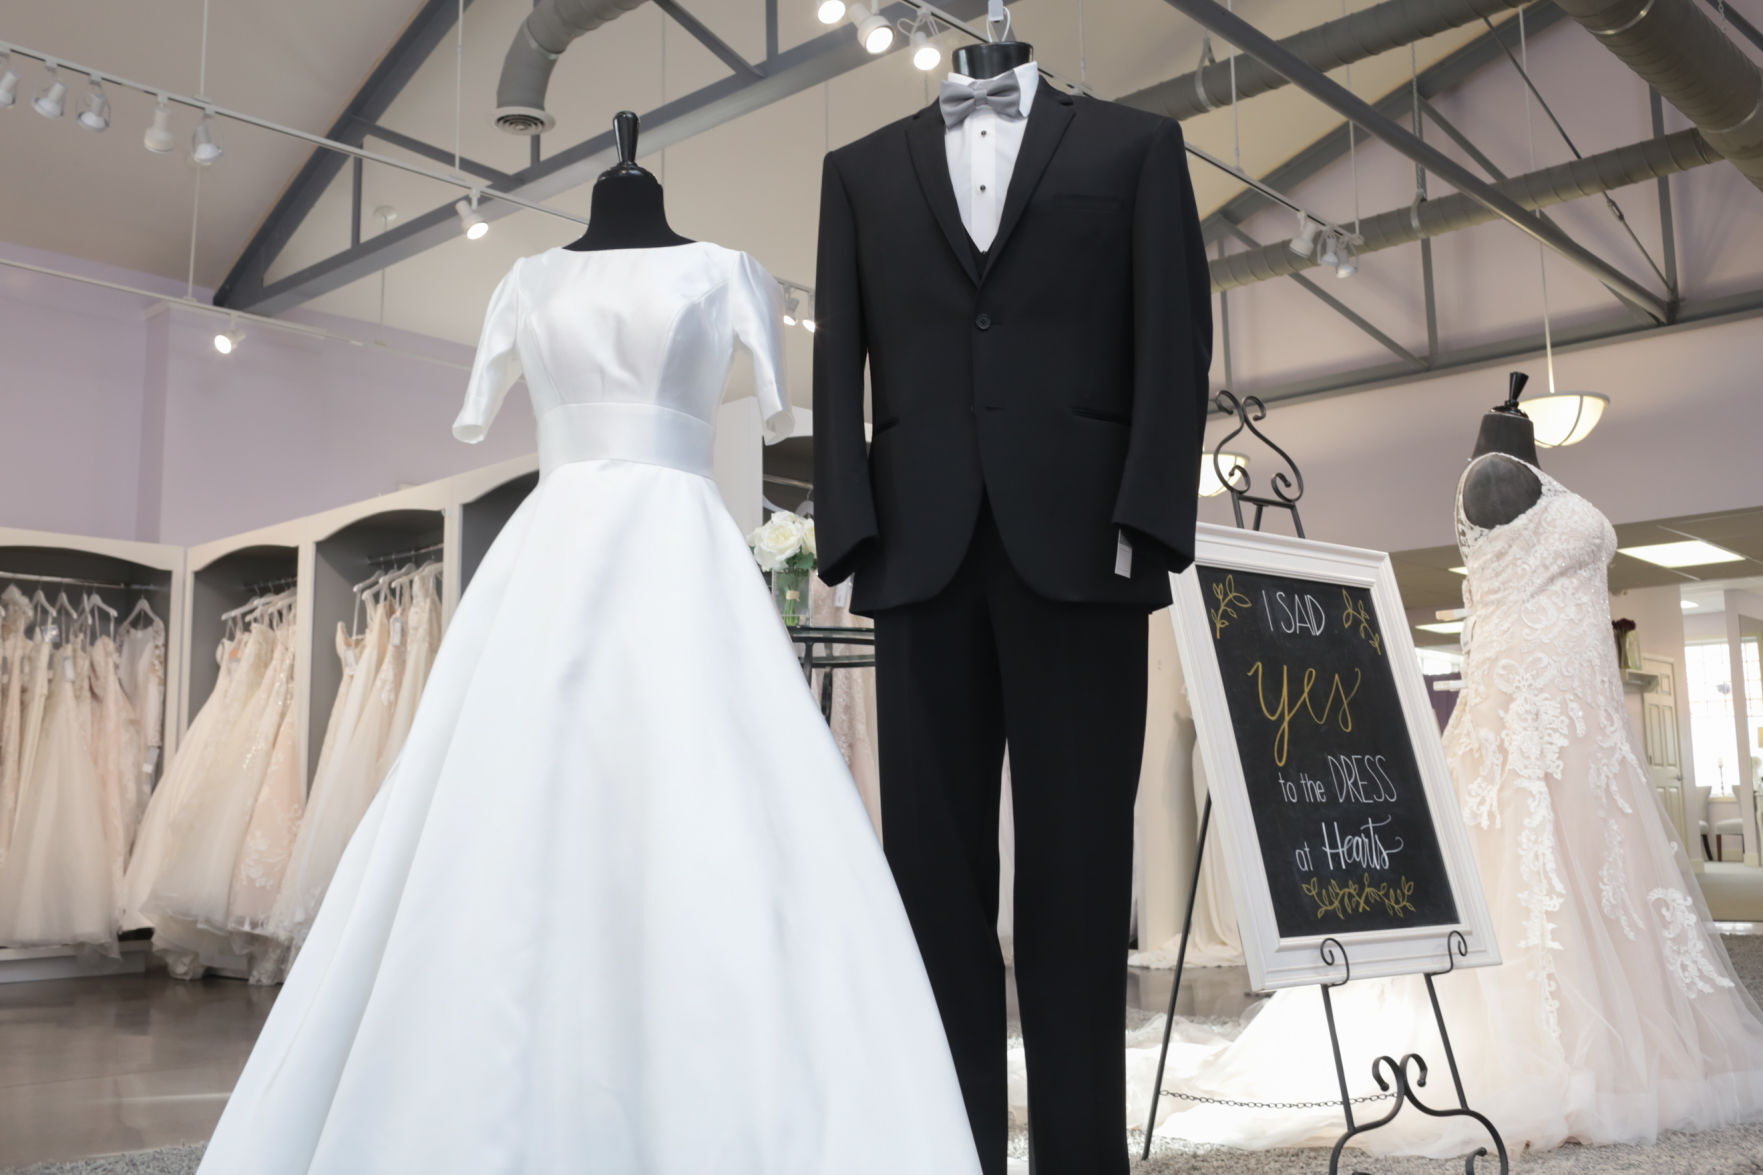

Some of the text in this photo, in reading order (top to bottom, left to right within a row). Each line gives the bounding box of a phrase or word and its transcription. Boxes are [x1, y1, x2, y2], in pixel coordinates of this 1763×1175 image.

[1262, 589, 1274, 632] I
[1278, 754, 1397, 803] to the DRESS
[1295, 814, 1404, 871] at Hearts
